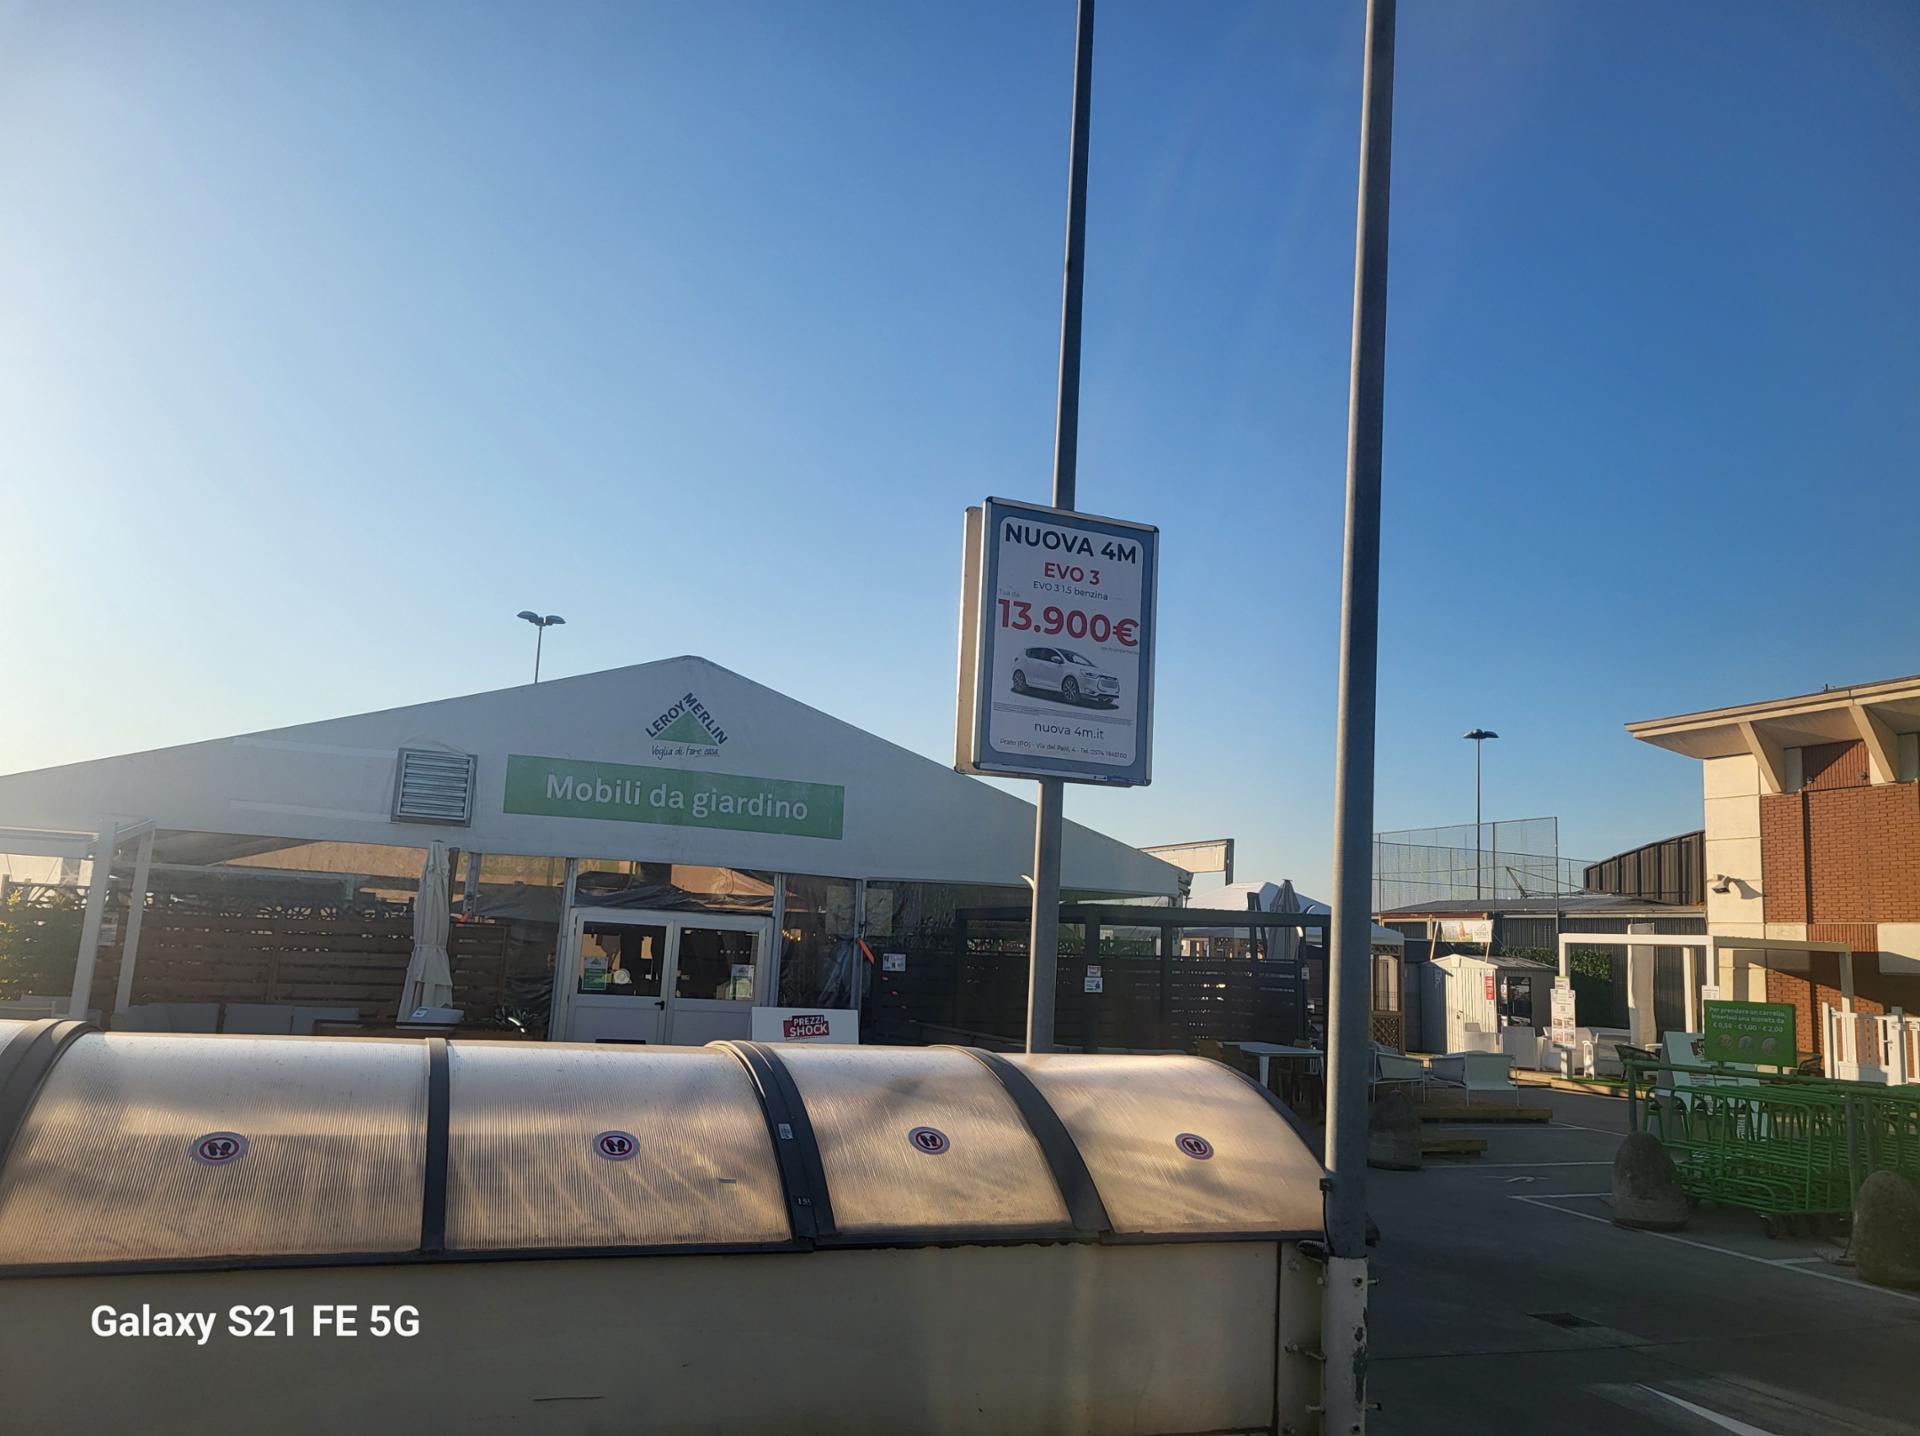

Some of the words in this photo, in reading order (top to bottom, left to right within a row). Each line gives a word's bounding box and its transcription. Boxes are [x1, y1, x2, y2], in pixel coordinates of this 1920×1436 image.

[1005, 522, 1094, 557] NUOVA
[1101, 541, 1137, 564] 4M
[1044, 561, 1084, 582] EVO
[1089, 569, 1101, 586] 3
[1033, 580, 1053, 591] EVO
[1053, 584, 1060, 593] 3
[1074, 588, 1109, 601] benzina
[998, 598, 1139, 647] 13.900€
[645, 700, 686, 738] LEROY
[683, 692, 728, 745] MERLIN
[1034, 722, 1071, 736] nuova
[1074, 726, 1105, 740] 4m.it
[545, 773, 641, 806] Mobili
[650, 783, 684, 809] da
[692, 787, 808, 820] giardino
[789, 1023, 828, 1037] SHOCK
[793, 1016, 824, 1027] PREZZI
